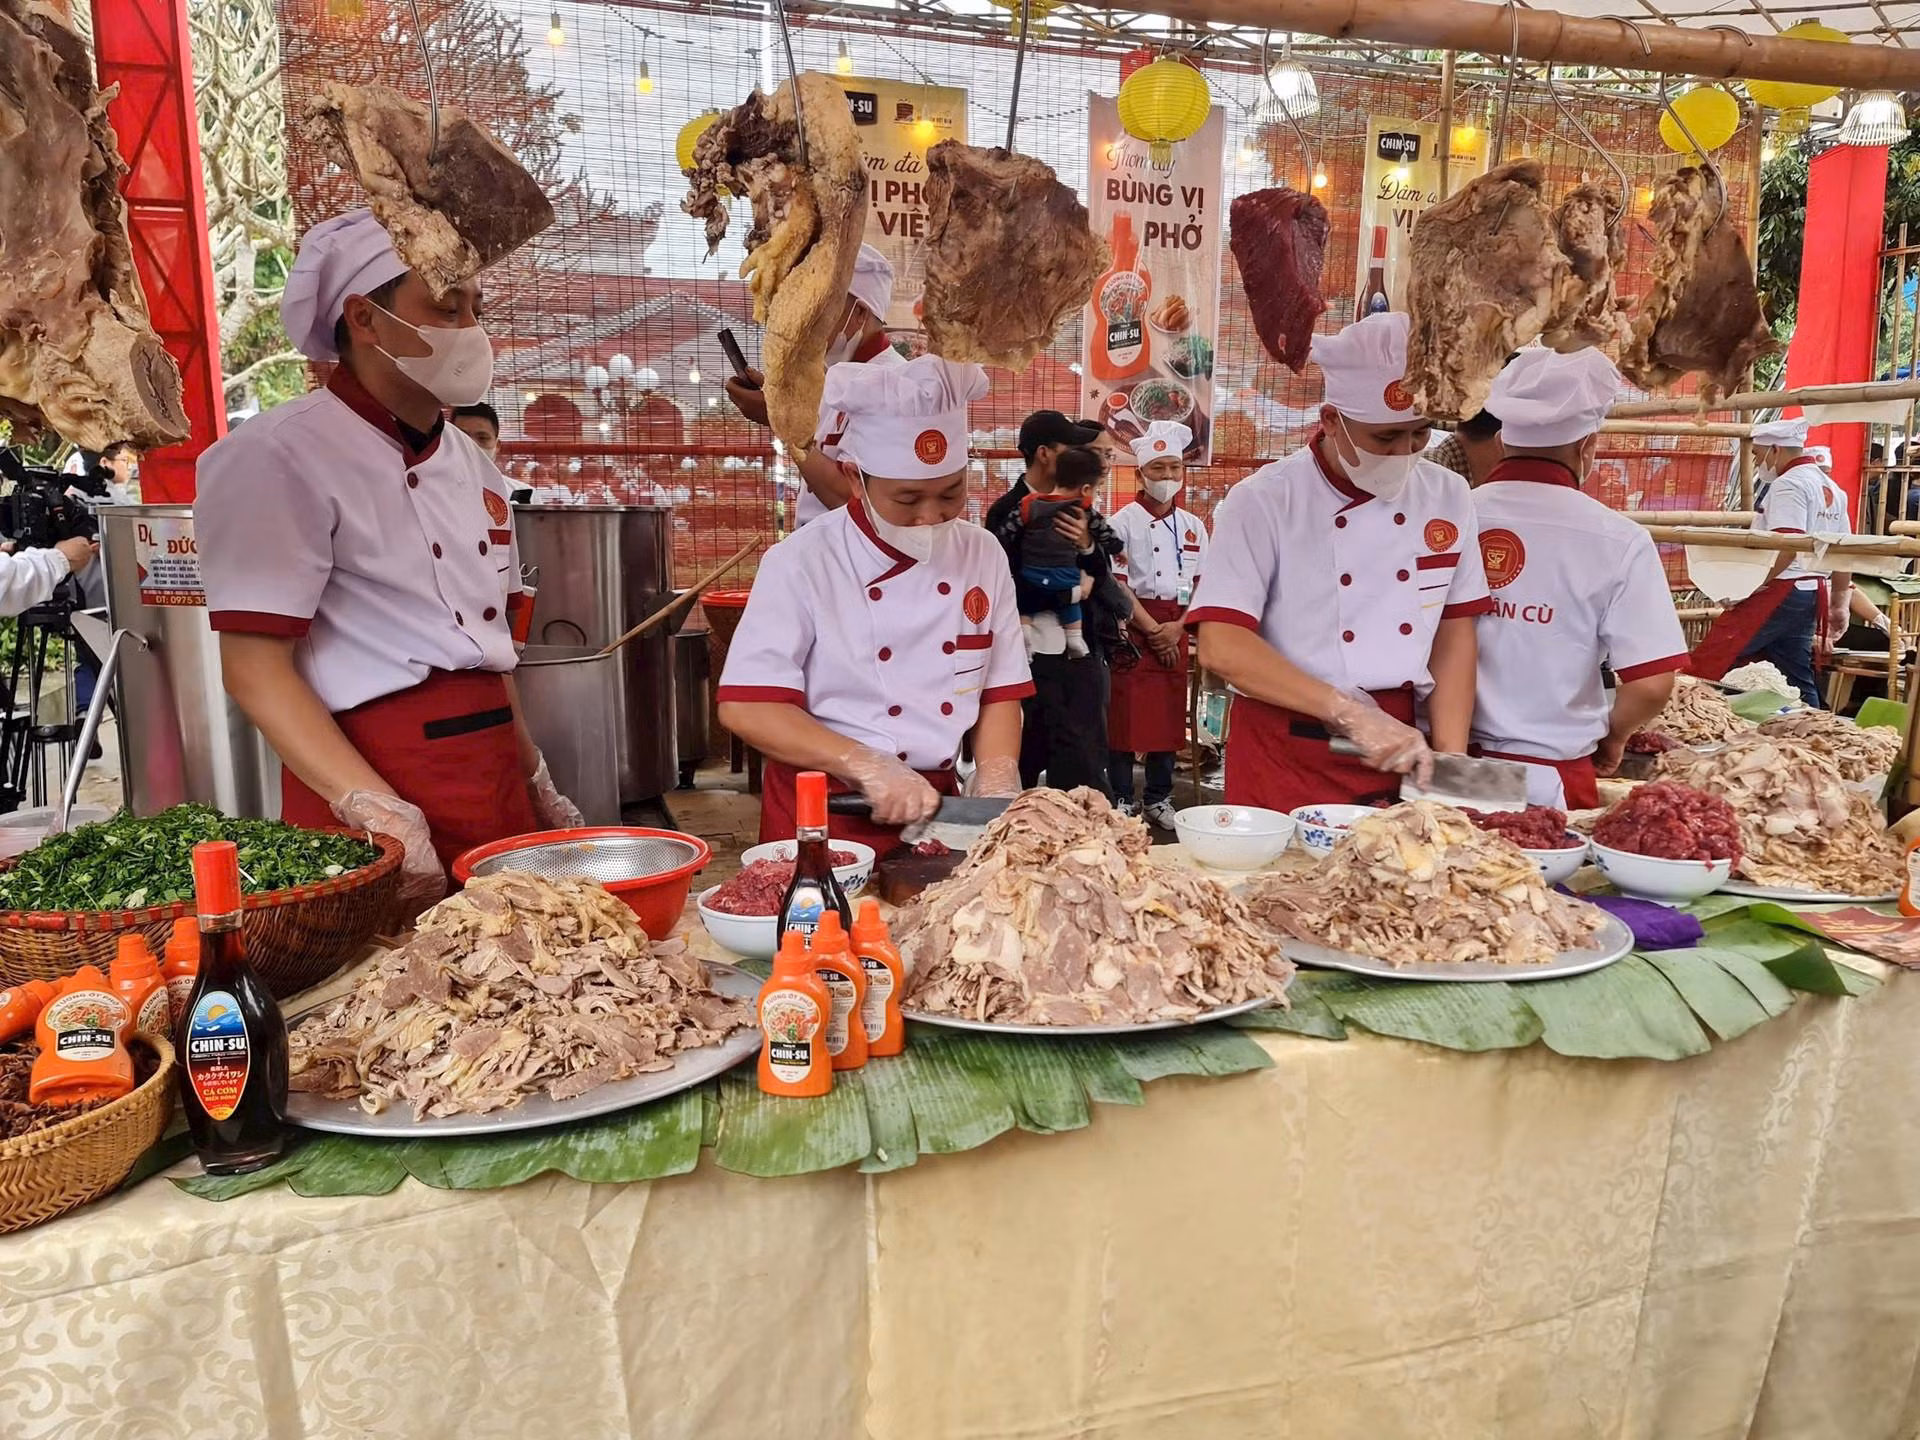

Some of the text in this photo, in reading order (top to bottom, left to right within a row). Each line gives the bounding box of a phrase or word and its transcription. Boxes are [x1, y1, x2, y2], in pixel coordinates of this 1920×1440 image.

[1106, 173, 1204, 215] BÙNG VỊ
[877, 207, 930, 244] VIỆ
[1392, 208, 1414, 234] VỊ
[1144, 214, 1203, 250] PHỞ
[1109, 328, 1140, 342] CHIN-SU
[170, 596, 193, 605] 0975
[1488, 597, 1554, 624] ÂN CÙ
[788, 923, 819, 934] CHIN-S
[60, 1034, 112, 1045] CHIN-SU
[191, 1038, 246, 1053] CHIN-SU
[771, 1048, 808, 1060] CHIN-SU
